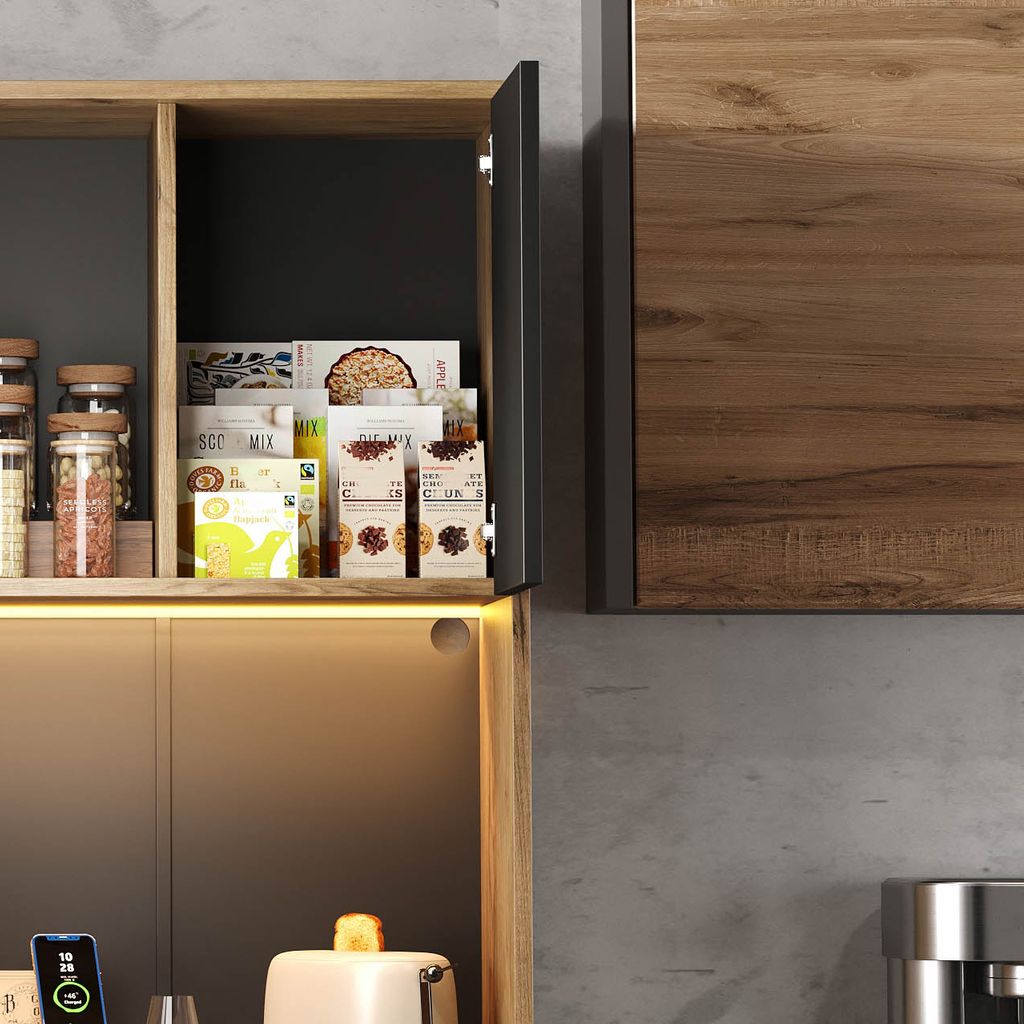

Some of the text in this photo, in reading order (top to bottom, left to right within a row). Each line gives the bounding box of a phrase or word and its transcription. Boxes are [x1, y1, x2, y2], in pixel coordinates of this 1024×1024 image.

[436, 359, 446, 389] APPLE
[294, 419, 318, 437] MIX
[249, 433, 274, 450] MIX
[388, 433, 412, 450] MIX
[58, 952, 73, 962] 10
[59, 963, 75, 973] 28
